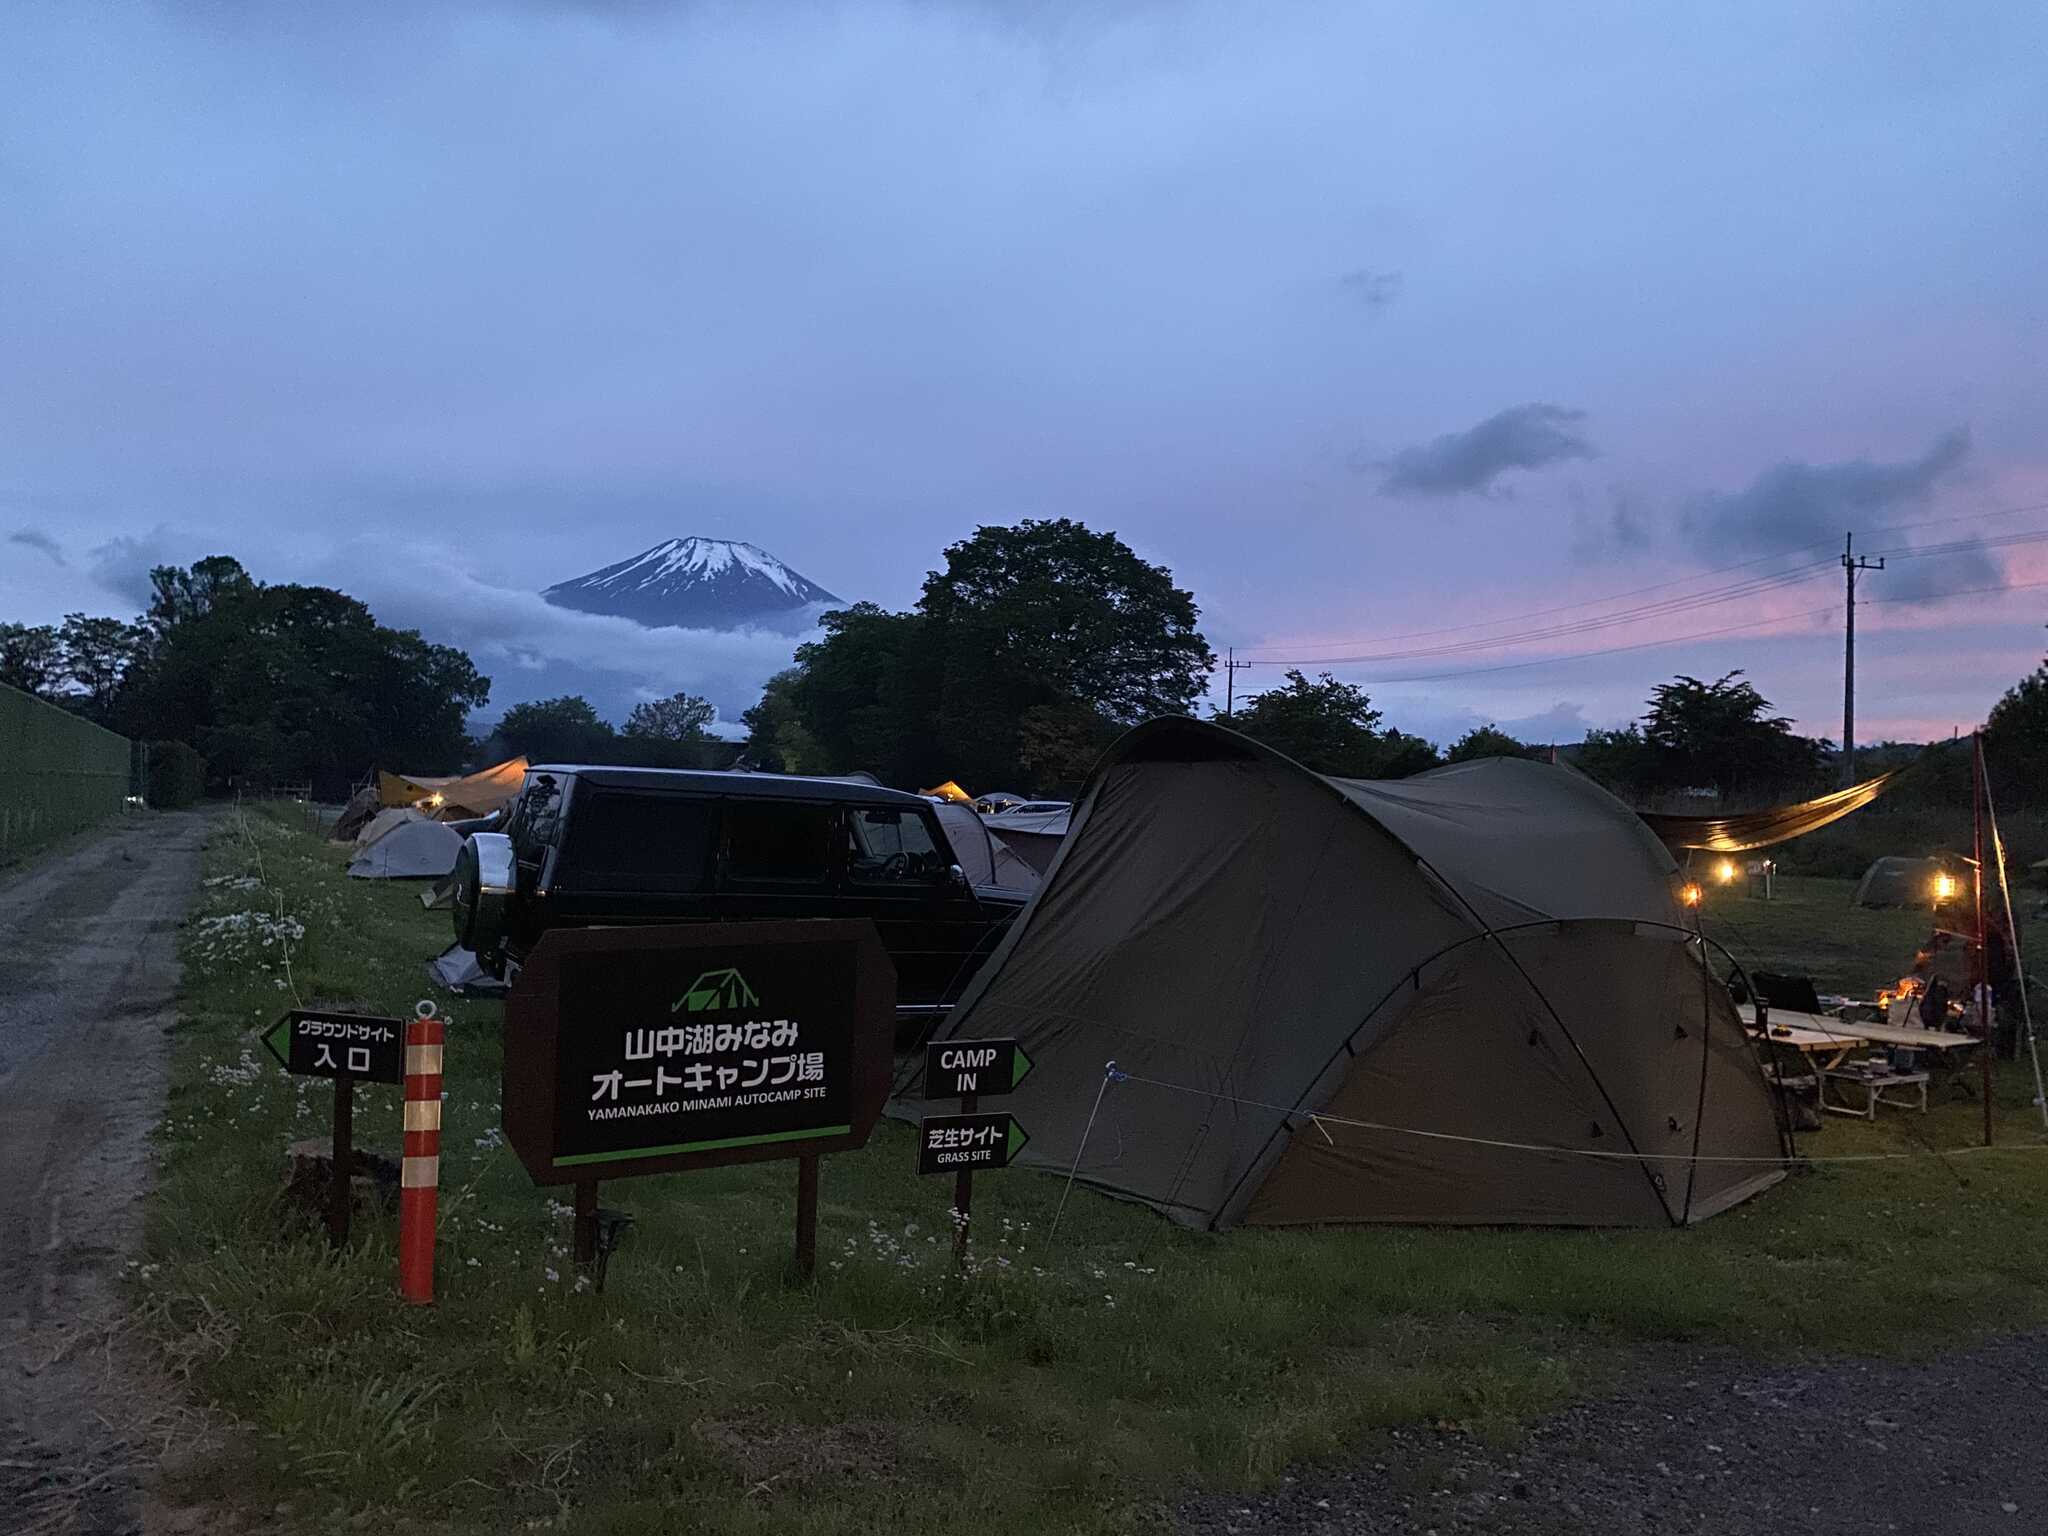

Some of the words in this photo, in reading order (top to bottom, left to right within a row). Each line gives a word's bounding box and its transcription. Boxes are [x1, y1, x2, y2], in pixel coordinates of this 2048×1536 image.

[298, 1020, 395, 1042] グラウンドサイト
[625, 1020, 798, 1060] 山中湖みなみ
[940, 1048, 997, 1070] CAMP
[591, 1052, 824, 1101] オートキャンプ場
[956, 1073, 977, 1092] IN
[588, 1101, 680, 1121] YAMANAKAKO
[682, 1096, 732, 1112] MINAMI
[734, 1089, 801, 1107] AUTOCAMP
[803, 1086, 826, 1099] SITE
[928, 1126, 1003, 1149] 芝生サイト
[937, 1152, 970, 1164] GRASS
[971, 1150, 991, 1161] SITE
